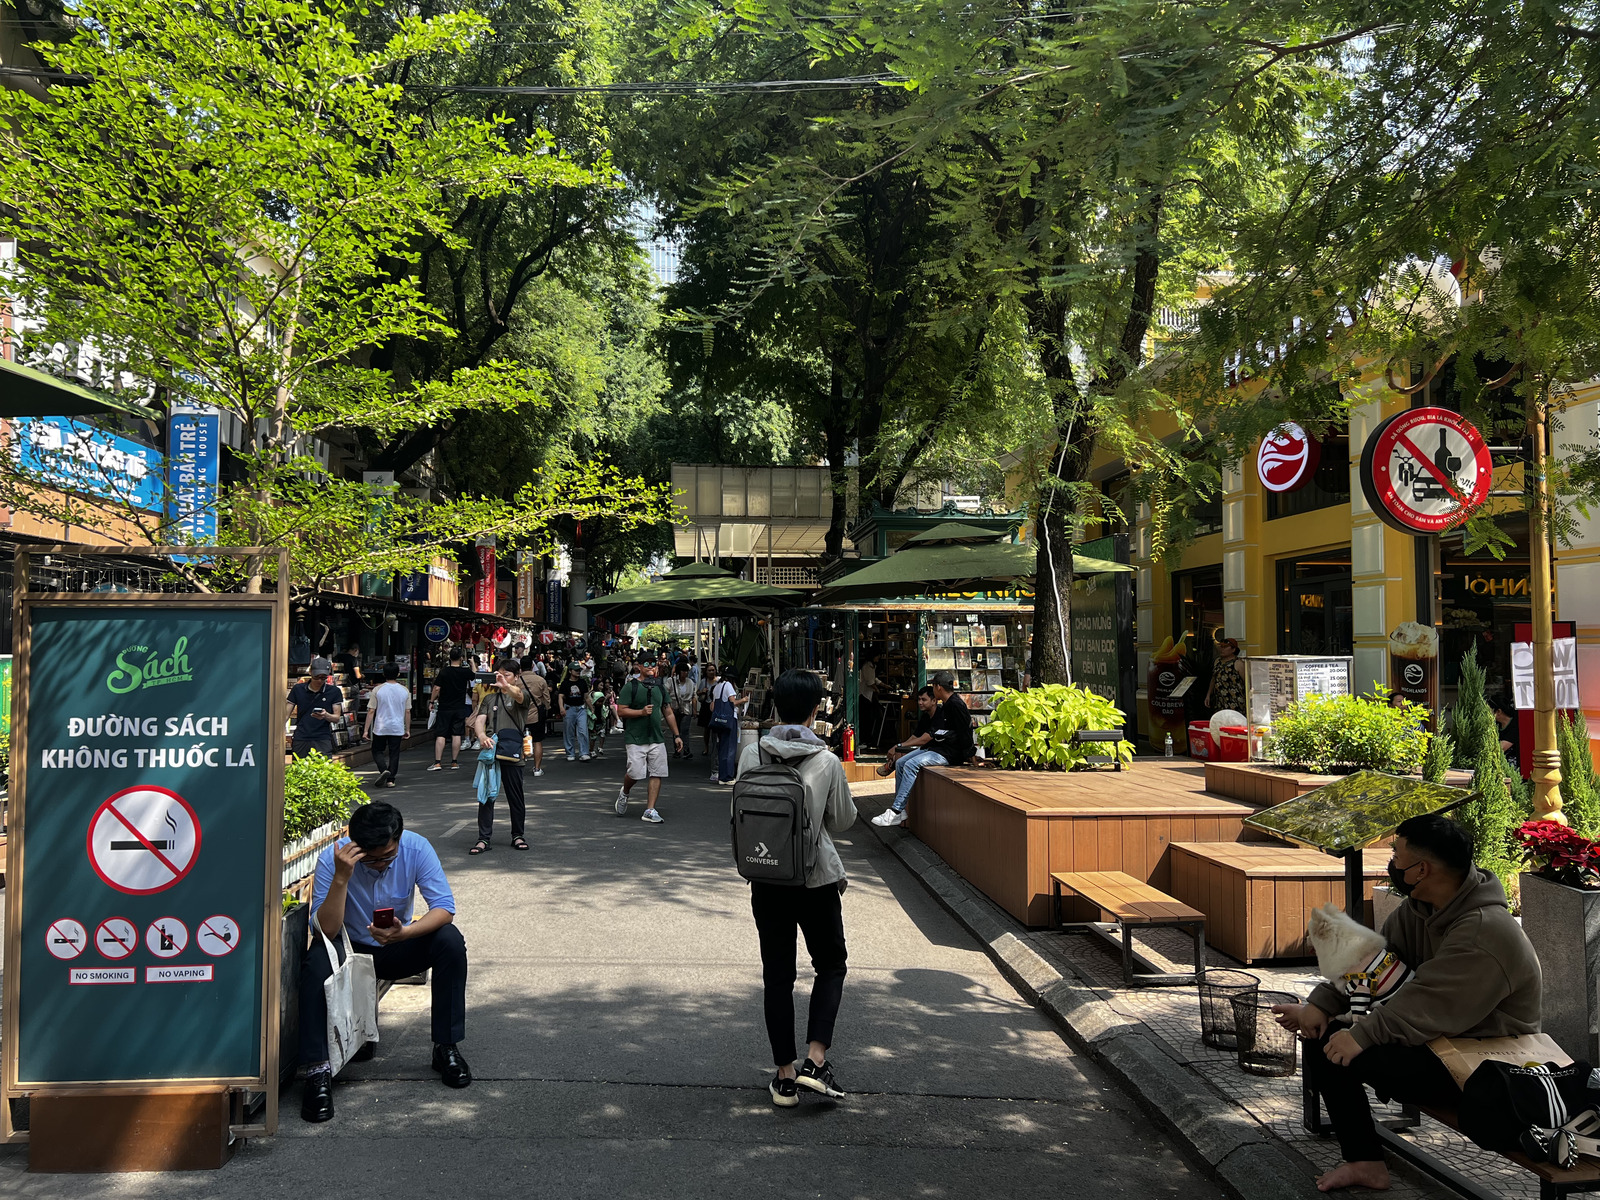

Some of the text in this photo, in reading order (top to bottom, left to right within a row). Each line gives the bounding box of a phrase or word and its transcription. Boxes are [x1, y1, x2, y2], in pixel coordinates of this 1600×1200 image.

[198, 422, 208, 457] HOUSE
[1386, 491, 1393, 499] AN
[107, 635, 193, 694] Sách
[67, 713, 228, 737] ĐƯỜNG SÁCH
[41, 742, 255, 769] KHÔNG THUỐC LÁ
[745, 855, 779, 866] CONVERSE
[89, 972, 129, 980] SMOKING
[173, 969, 205, 977] VAPING
